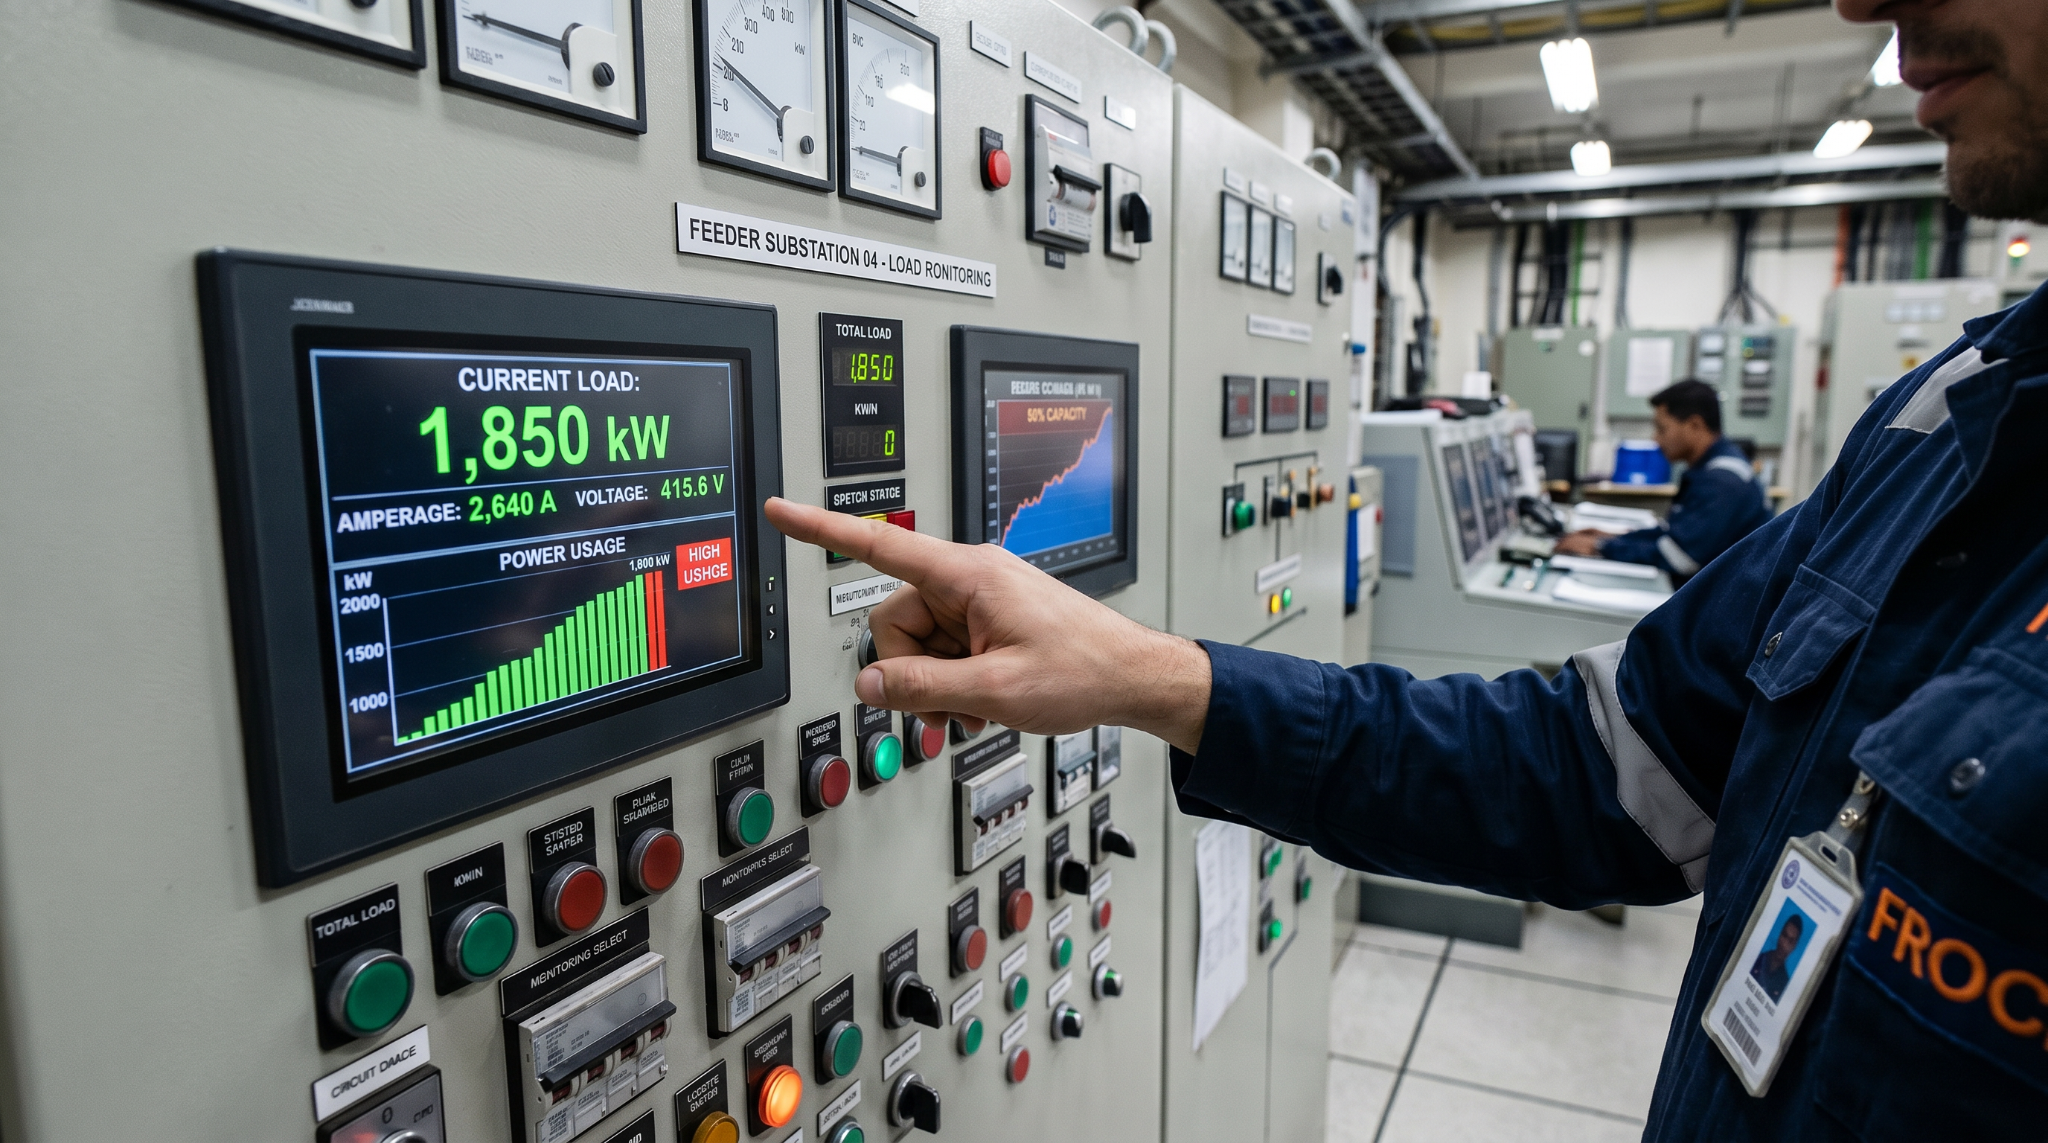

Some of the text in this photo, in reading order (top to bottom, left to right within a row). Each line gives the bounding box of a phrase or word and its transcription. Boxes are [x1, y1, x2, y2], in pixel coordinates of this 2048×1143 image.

[744, 16, 758, 34] 300
[689, 217, 761, 250] FEEDER
[765, 231, 860, 266] SUBSTATION
[863, 249, 878, 269] 04
[889, 254, 922, 276] LOAD
[925, 261, 991, 287] RONITORING
[836, 323, 892, 339] TOTAL LOAD
[458, 367, 640, 392] CURRENT LOAD:
[850, 353, 894, 383] 1,850
[1046, 406, 1087, 422] CAPACITY
[419, 404, 671, 485] 1,850 kW
[884, 429, 895, 456] 0
[575, 473, 725, 507] VOLTAGE: 415.6 V
[337, 490, 558, 533] AMPERAGE: 2,640 A
[499, 536, 626, 571] POWER USAGE
[629, 553, 671, 572] 1,800 kW
[688, 543, 721, 563] HIGH
[344, 571, 373, 591] kW
[683, 562, 729, 585] USHGE
[340, 593, 381, 616] 2000
[345, 641, 385, 664] 1500
[349, 691, 388, 714] 1000
[768, 842, 794, 863] SELECT
[315, 898, 396, 939] TOTAL LOAD
[593, 929, 628, 956] SELECT
